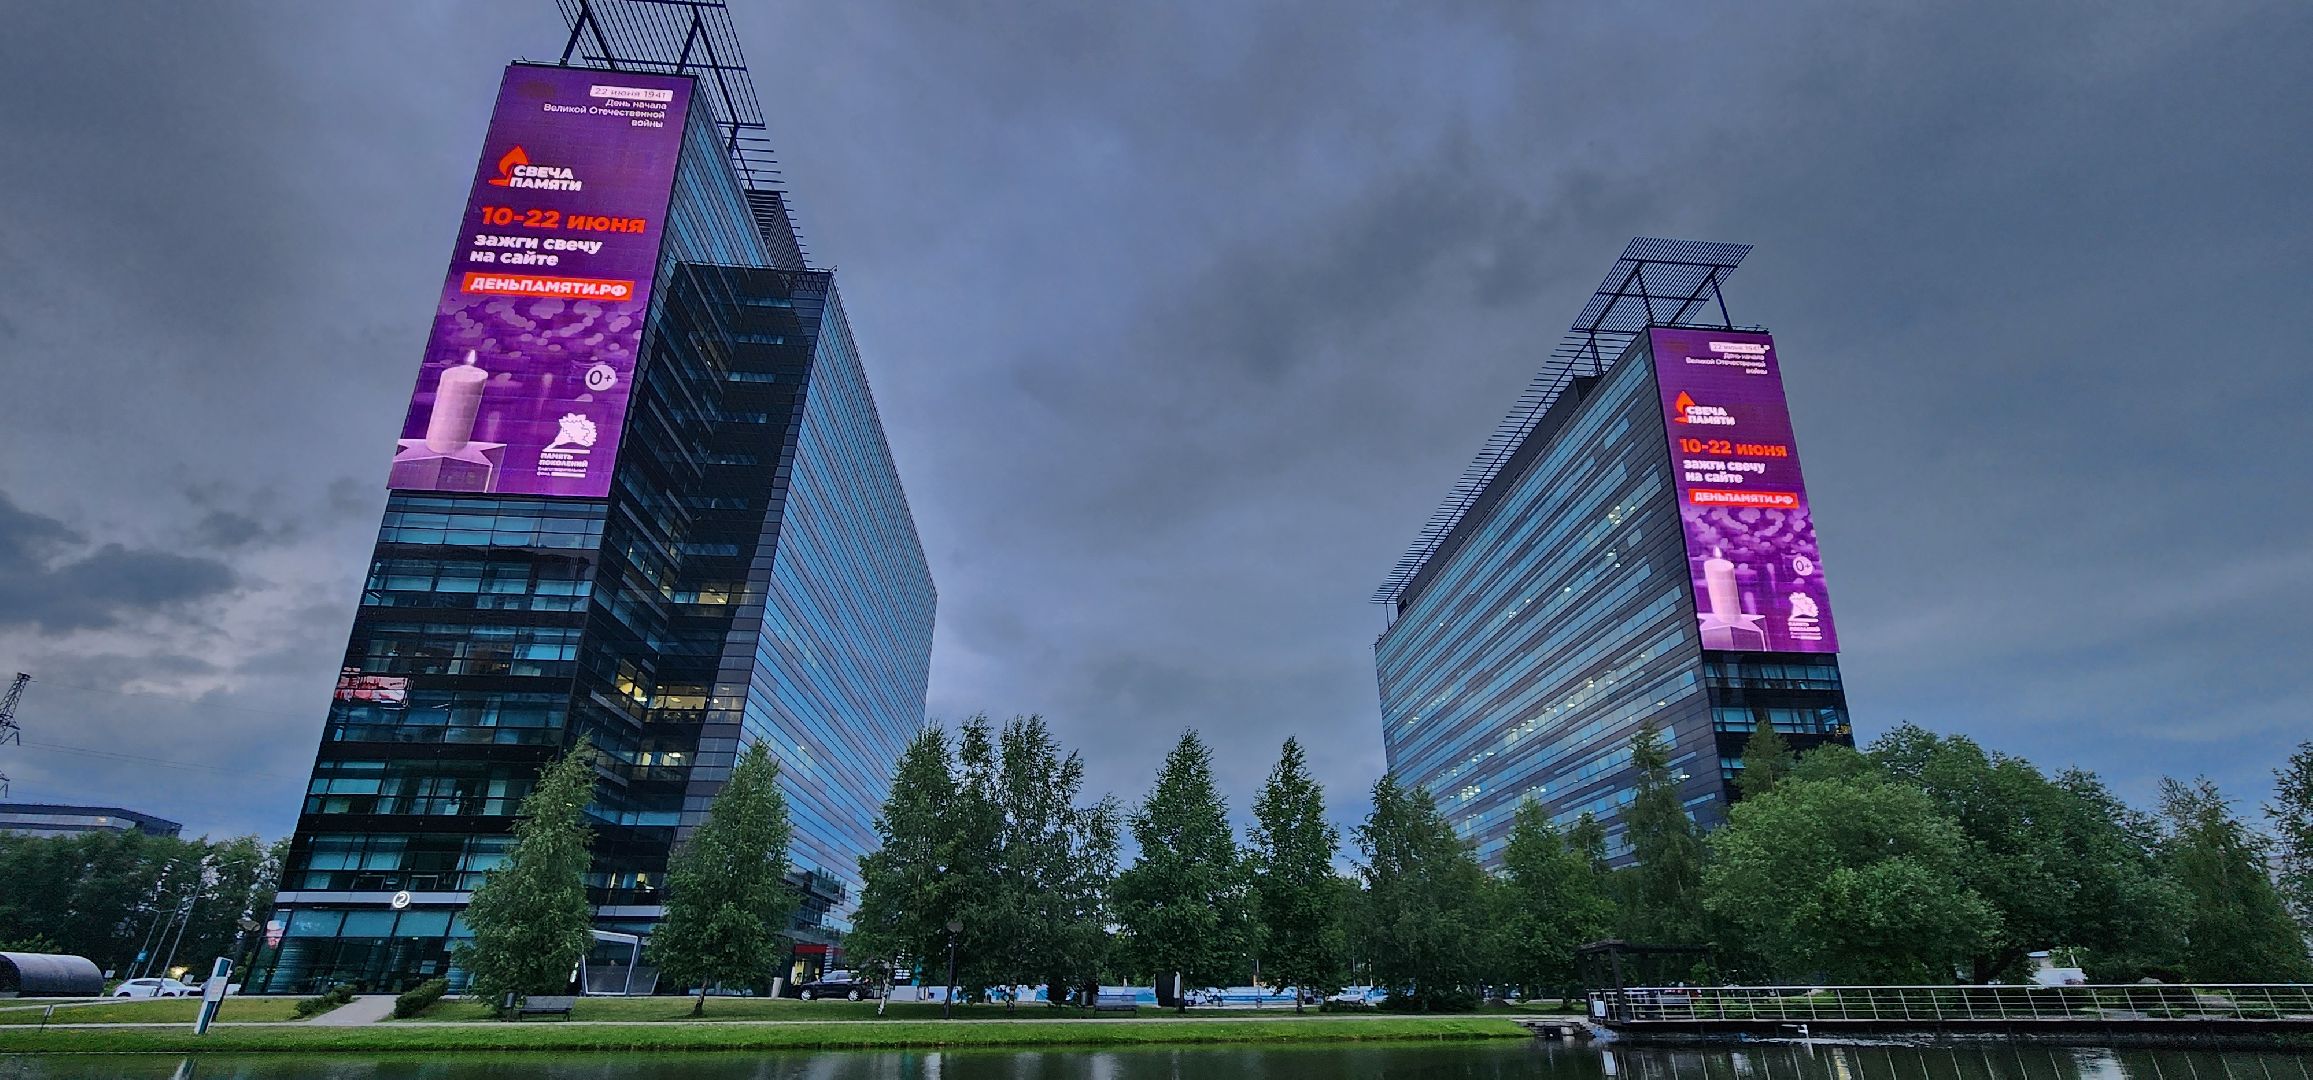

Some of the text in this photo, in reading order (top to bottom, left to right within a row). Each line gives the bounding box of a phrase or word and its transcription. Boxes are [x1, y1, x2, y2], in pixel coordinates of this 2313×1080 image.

[644, 91, 666, 99] 1941
[543, 103, 665, 119] Великой Отечественной
[605, 99, 667, 110] День начала
[631, 119, 664, 128] войны
[513, 164, 574, 180] СВЕЧА
[509, 176, 583, 192] ПАМЯТИ
[481, 206, 561, 229] 10-22
[474, 234, 603, 255] зажги свечу
[469, 250, 559, 266] на сайте
[470, 277, 628, 297] ДЕНЬПАМЯТИ.РФ
[1686, 406, 1728, 416] СВЕЧА
[1688, 415, 1736, 426] ПАМЯТИ
[1680, 438, 1732, 454] 10-22
[1683, 459, 1766, 474] зажги свечу
[1685, 470, 1744, 483] на сайте
